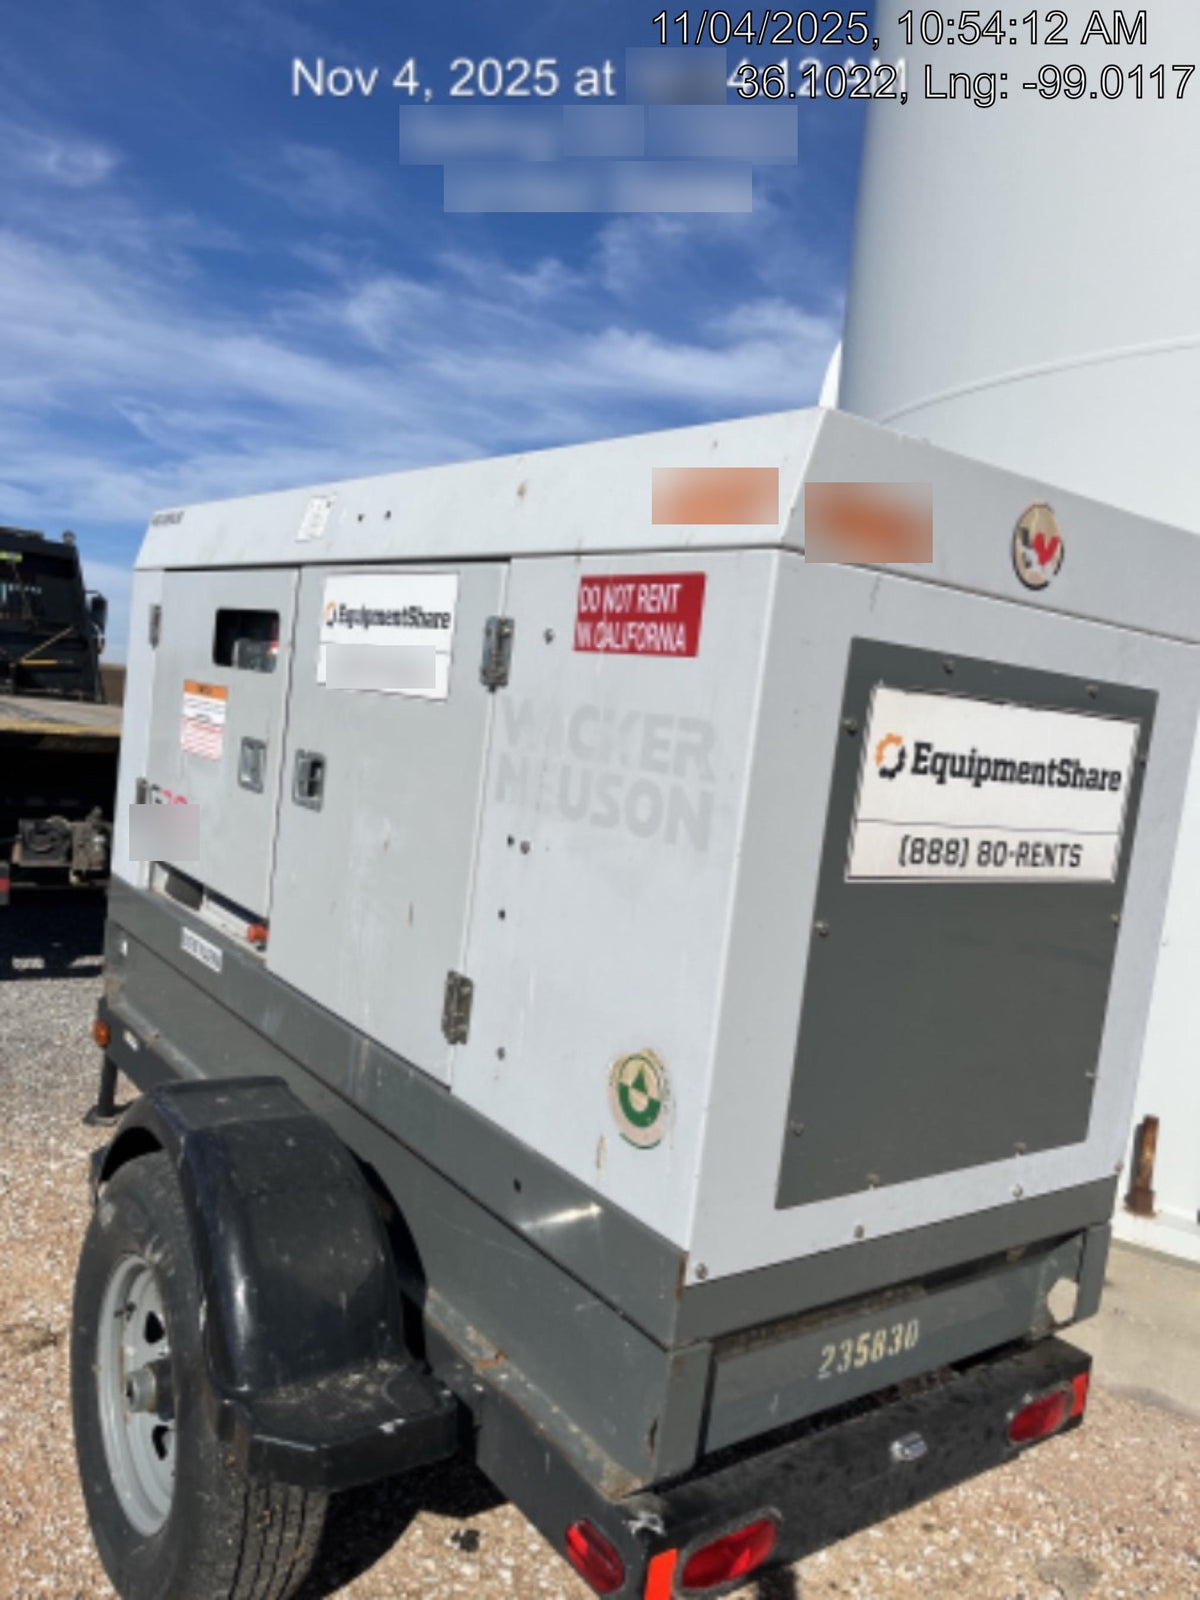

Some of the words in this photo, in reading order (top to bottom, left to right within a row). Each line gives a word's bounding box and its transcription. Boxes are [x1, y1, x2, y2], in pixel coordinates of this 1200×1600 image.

[580, 583, 601, 613] DO
[602, 583, 635, 613] NOT
[636, 582, 682, 613] RENT
[593, 620, 687, 653] CALIFORNIA
[910, 740, 1122, 792] EquipmentShare
[899, 834, 969, 868] (888)
[976, 839, 1083, 868] 80-RENTS
[817, 1317, 920, 1380] 235830
